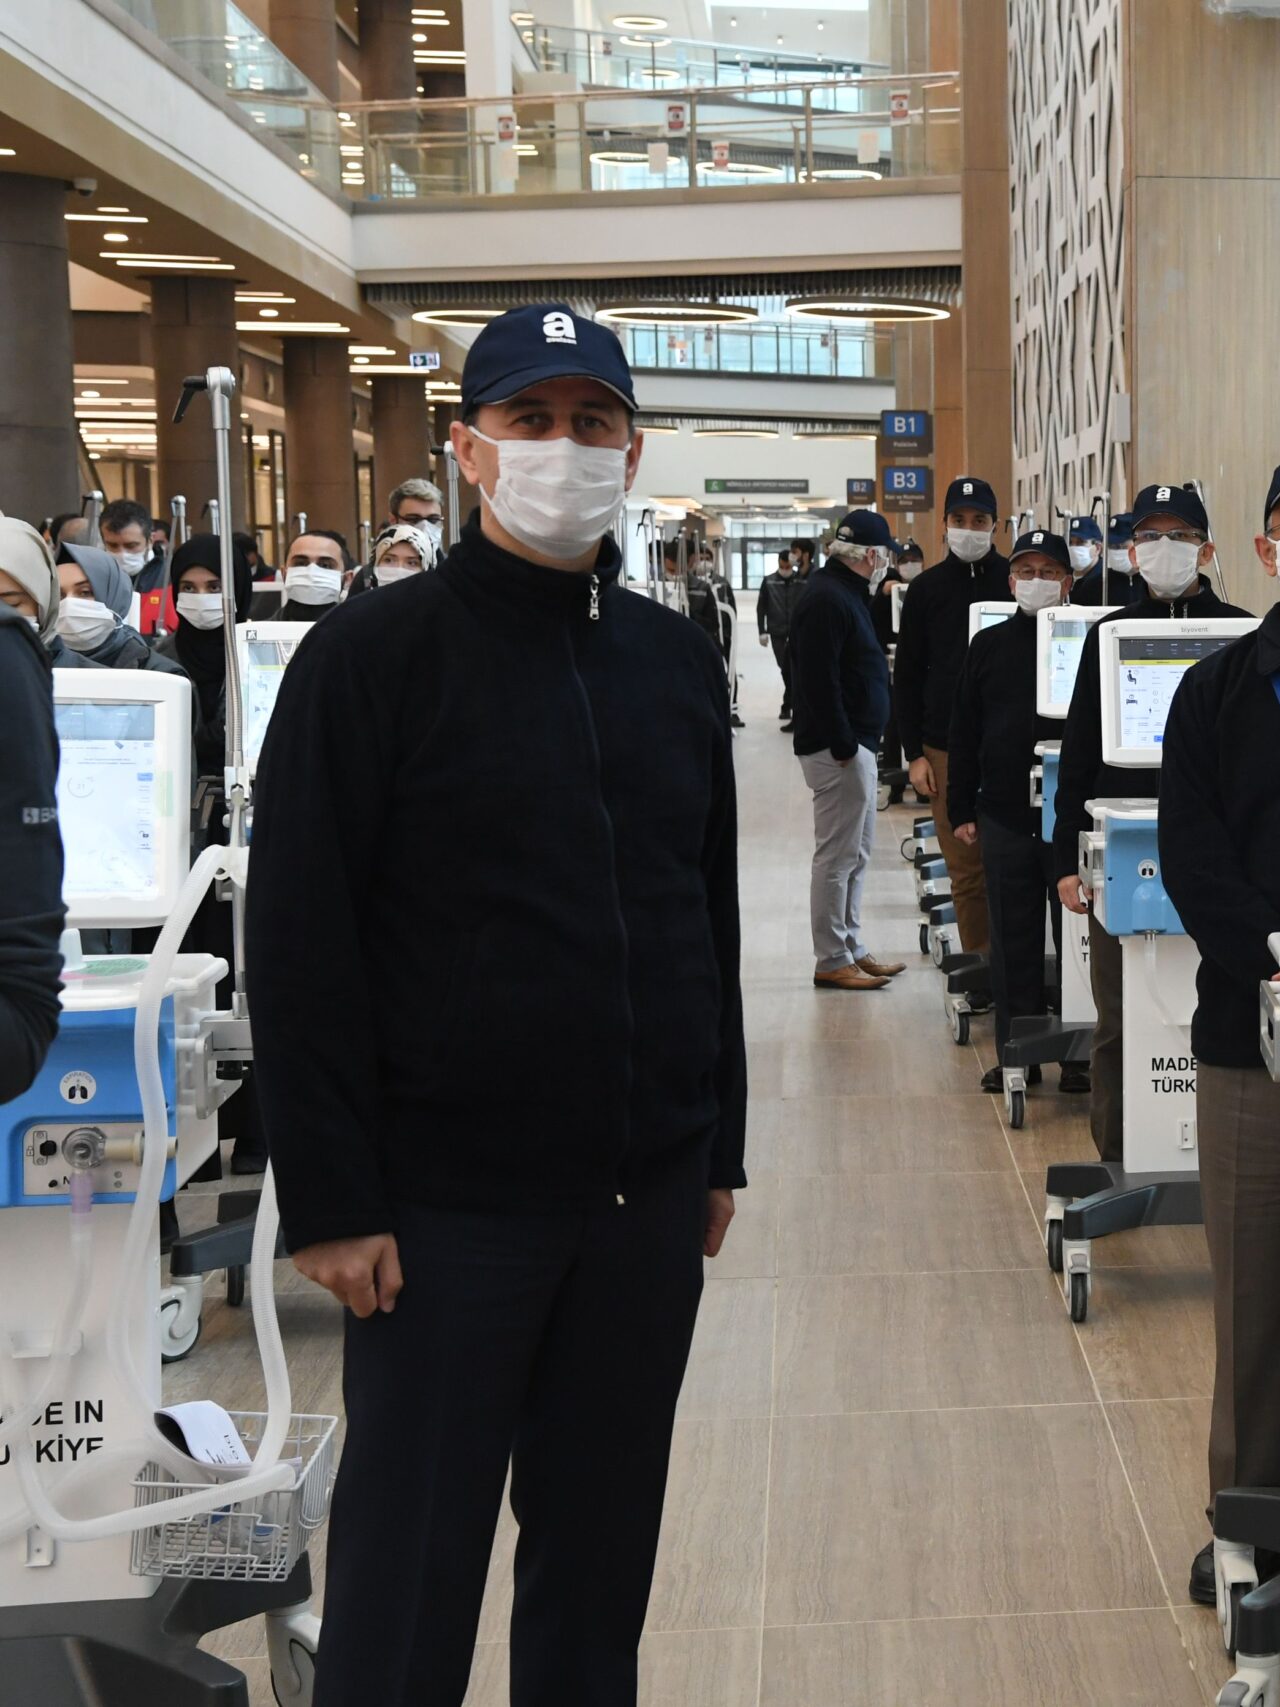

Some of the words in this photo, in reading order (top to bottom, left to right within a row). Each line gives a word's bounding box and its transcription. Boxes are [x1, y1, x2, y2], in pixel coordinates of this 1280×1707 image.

[543, 311, 576, 339] a
[894, 416, 915, 433] B1
[852, 481, 867, 493] B2
[893, 472, 917, 488] B3
[963, 483, 974, 494] a
[1156, 487, 1171, 499] a
[1031, 532, 1044, 543] a
[1151, 1076, 1197, 1093] TÜRK
[75, 1399, 103, 1424] IN
